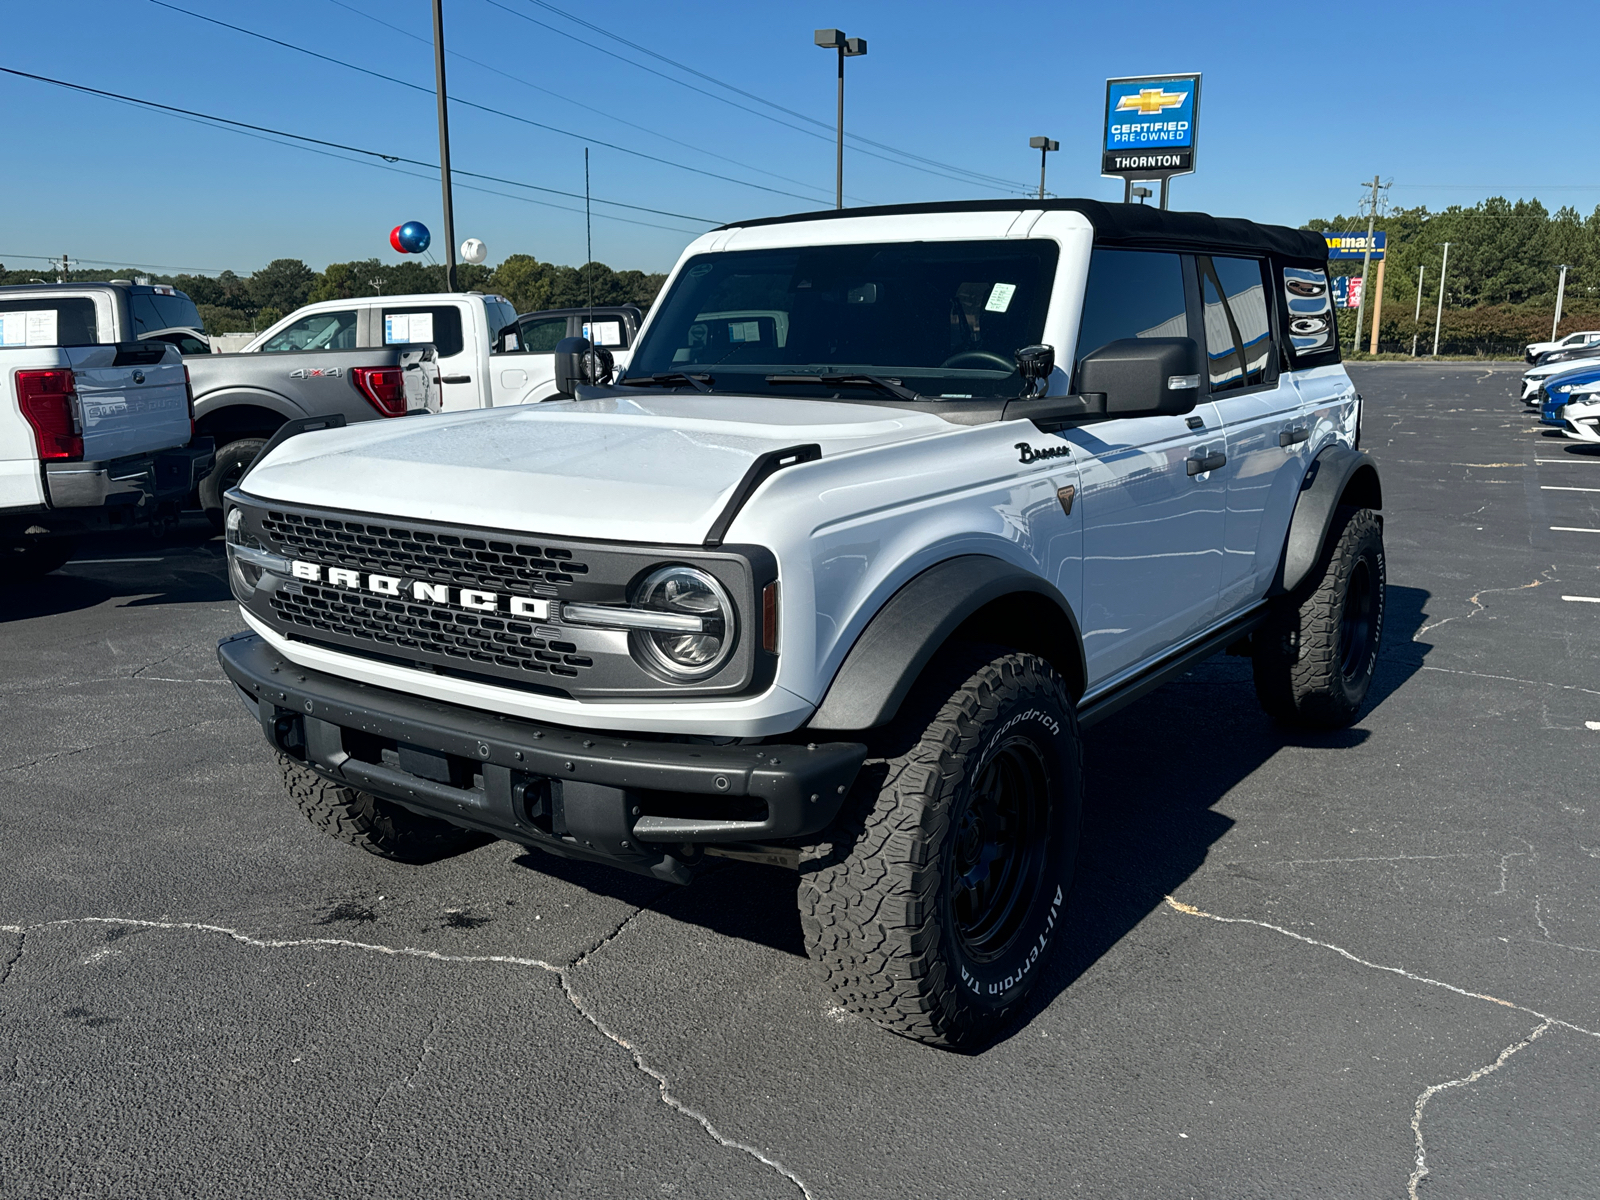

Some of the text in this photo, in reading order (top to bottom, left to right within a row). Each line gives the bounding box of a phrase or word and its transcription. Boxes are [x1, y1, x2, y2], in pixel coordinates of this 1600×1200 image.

[1111, 121, 1188, 134] CERTIFIED
[1114, 131, 1184, 143] PRE-OWNED
[1115, 155, 1181, 169] THORNTON
[89, 399, 179, 418] SUPER DUTY
[1014, 442, 1071, 464] Bronco
[292, 560, 550, 620] BRONCO
[960, 884, 1063, 996] All-Terrain T/A
